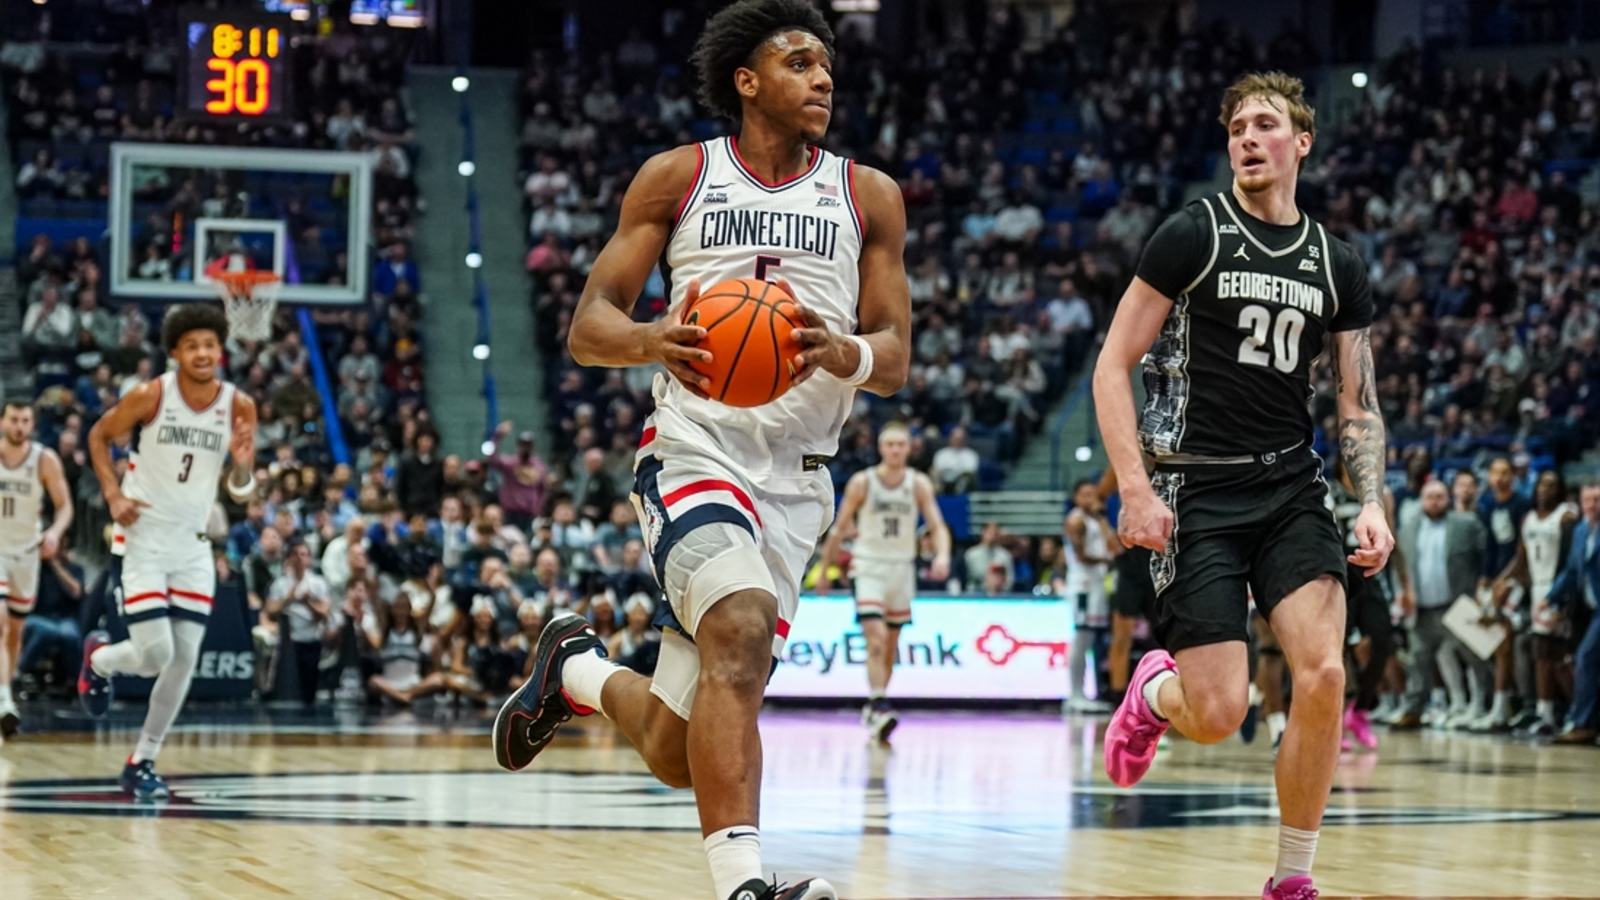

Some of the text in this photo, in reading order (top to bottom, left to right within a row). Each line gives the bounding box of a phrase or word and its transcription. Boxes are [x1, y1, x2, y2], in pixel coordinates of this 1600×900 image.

[213, 23, 279, 58] 8:11
[206, 58, 271, 115] 30
[700, 209, 841, 261] CONNECTICUT
[1217, 271, 1324, 318] GEORGETOWN
[1237, 304, 1306, 375] 20
[157, 424, 223, 453] CONNECTICUT
[178, 453, 194, 484] 3
[2, 496, 15, 518] 11
[194, 650, 255, 680] ERS
[780, 632, 960, 675] eyBnk
